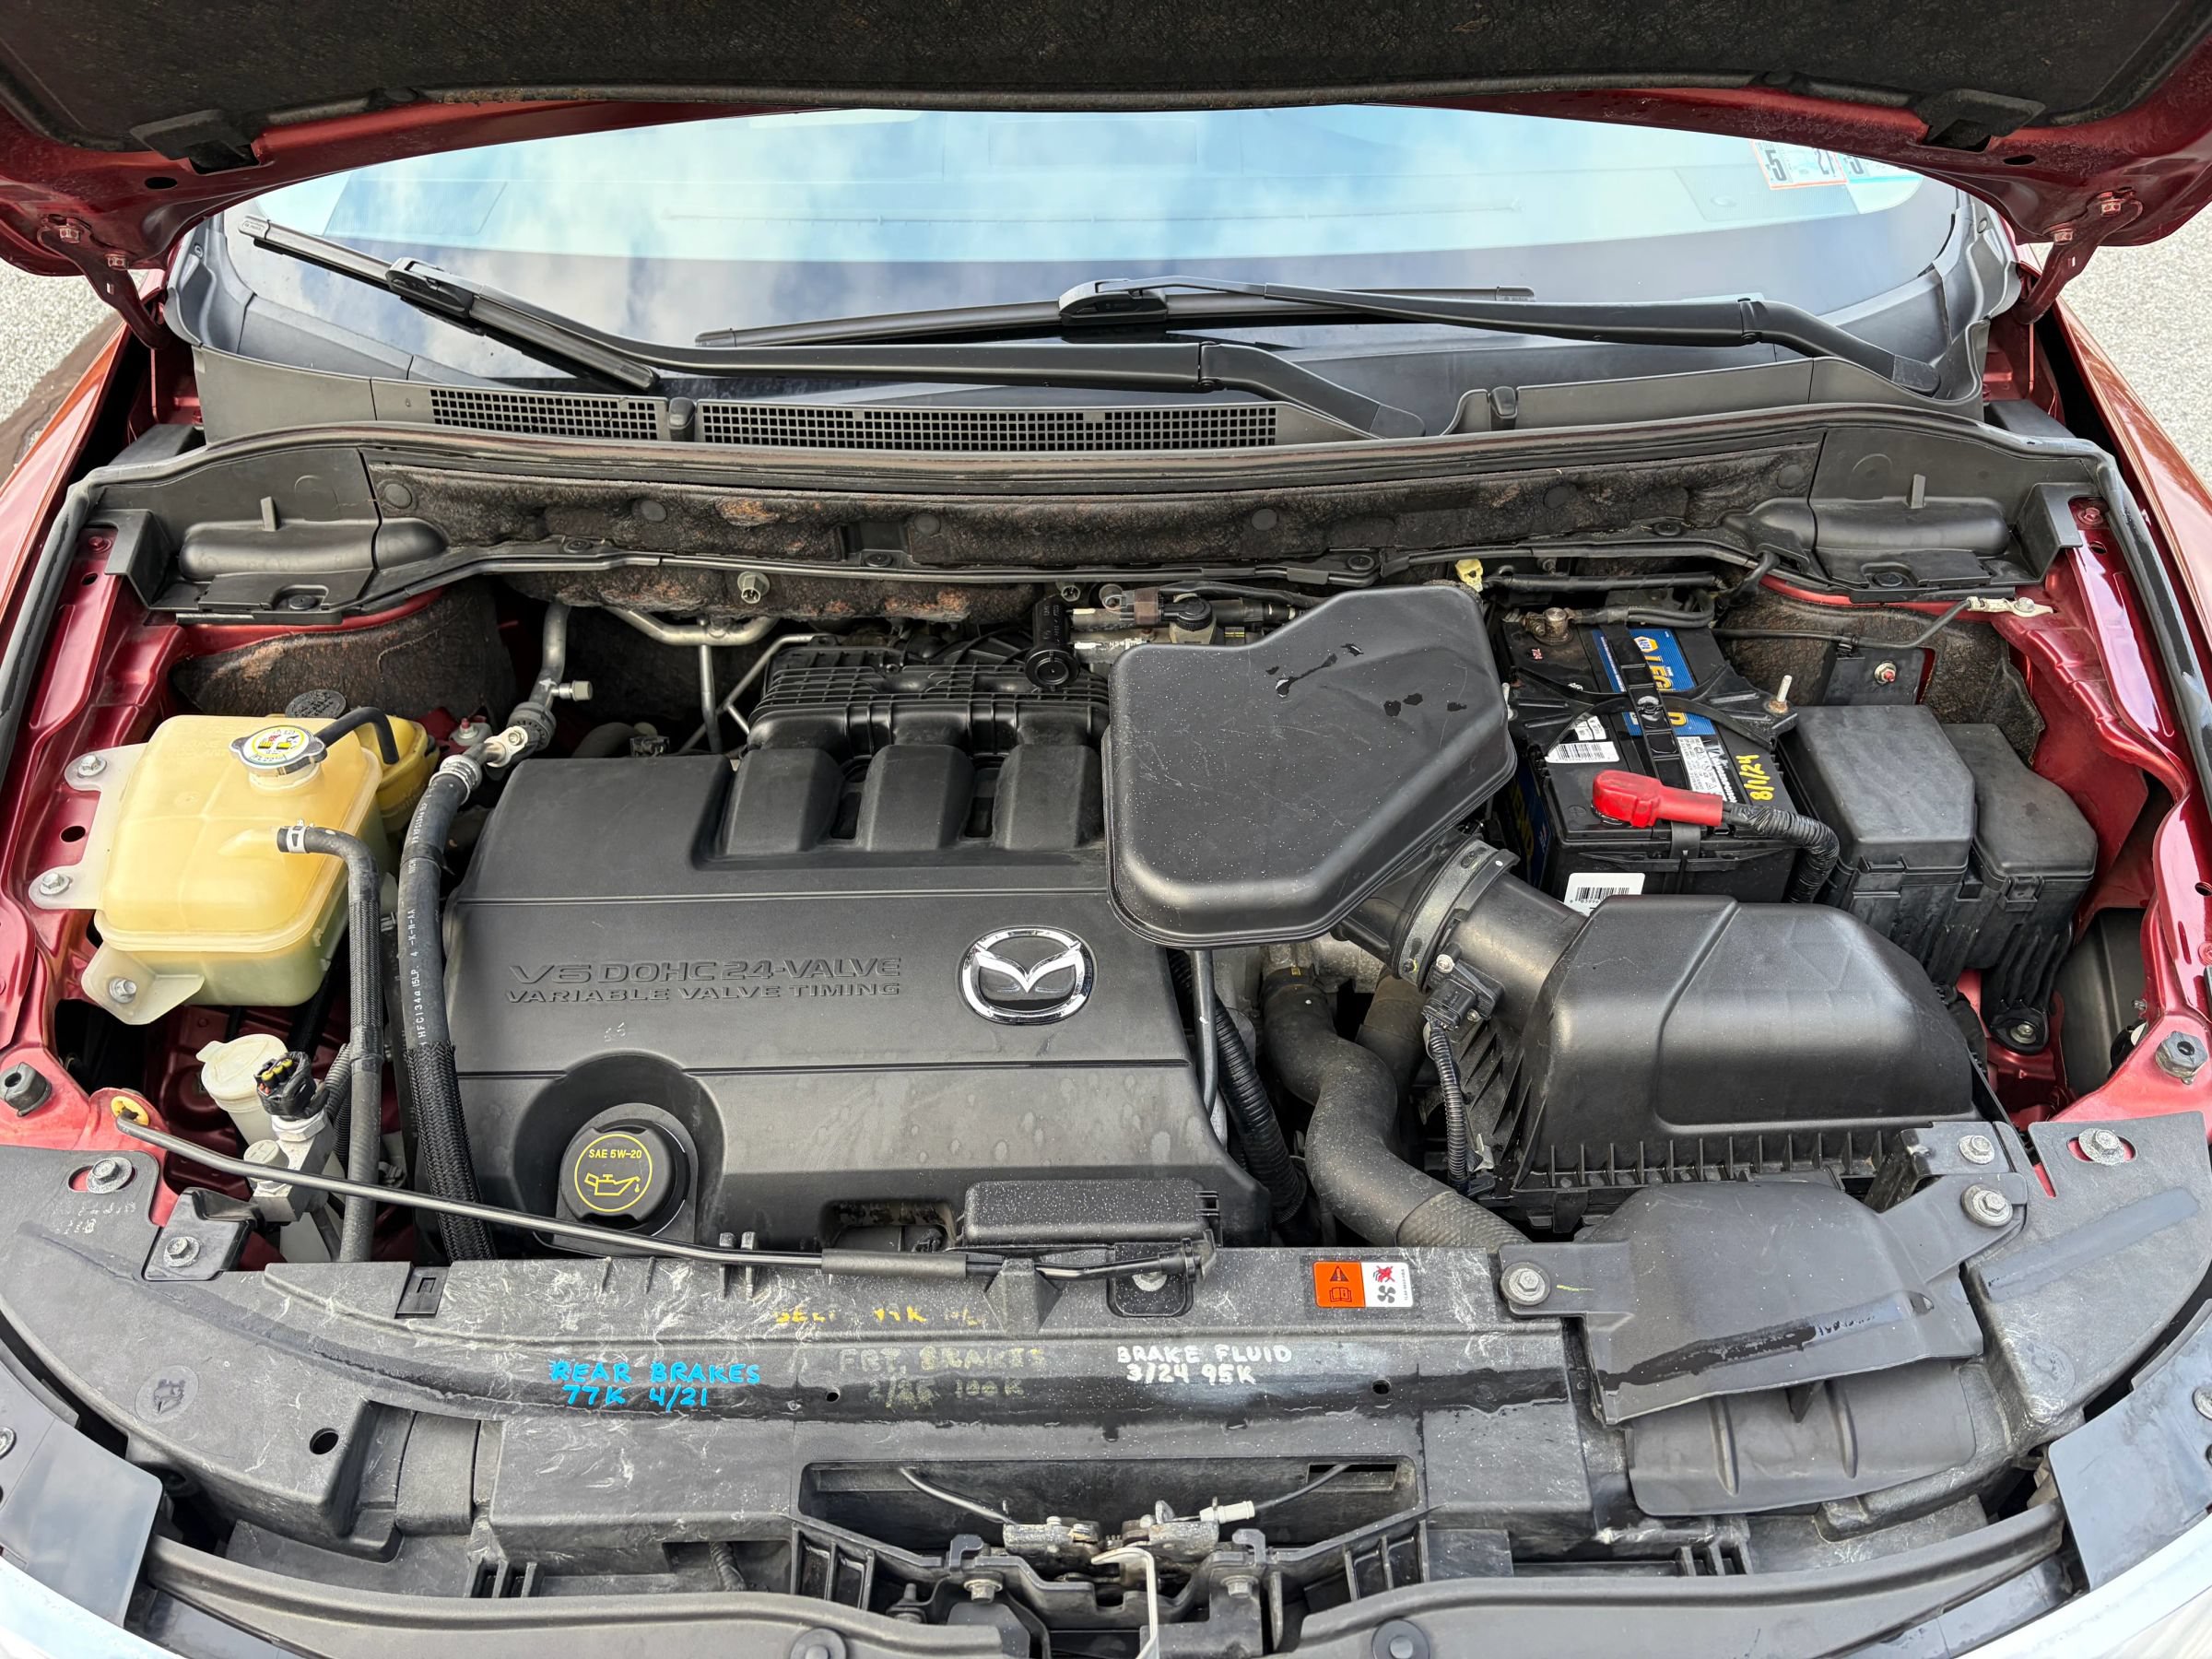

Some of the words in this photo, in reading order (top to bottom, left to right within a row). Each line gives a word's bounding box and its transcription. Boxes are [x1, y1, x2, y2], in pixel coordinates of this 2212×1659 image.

[1735, 754, 1775, 800] 8/1/24
[509, 963, 592, 984] V6
[597, 961, 716, 983] DOHC
[721, 957, 902, 982] 24-VALVE
[504, 988, 670, 1004] VARIABLE
[677, 985, 782, 1000] VALVE
[788, 982, 901, 997] TIMING
[589, 1148, 608, 1159] SAE
[609, 1148, 642, 1159] 5W-20
[1117, 1345, 1201, 1363] BRAKE
[1214, 1344, 1292, 1362] FLUID
[548, 1359, 632, 1382] REAR
[651, 1360, 761, 1384] BRAKES
[1126, 1362, 1190, 1384] 3/24
[1201, 1363, 1257, 1385] 95K
[562, 1384, 627, 1406] 77K
[648, 1383, 708, 1414] 4/21
